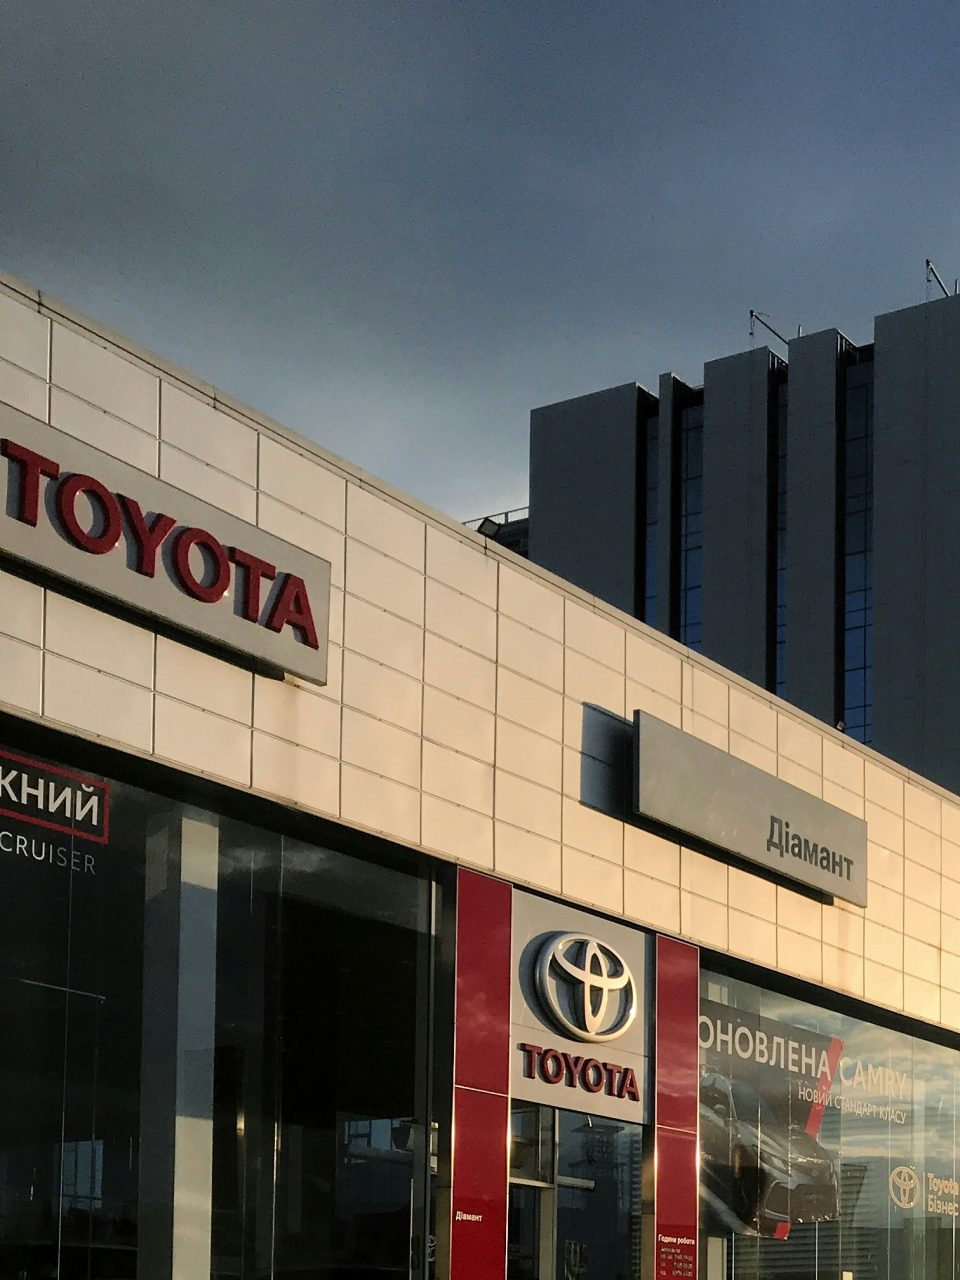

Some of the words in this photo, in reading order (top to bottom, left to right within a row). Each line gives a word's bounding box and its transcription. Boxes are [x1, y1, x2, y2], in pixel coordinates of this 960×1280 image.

[1, 438, 319, 650] TOYOTA
[0, 831, 97, 875] CRUISER
[767, 815, 854, 881] Діамант
[518, 1042, 640, 1102] TOYOTA
[699, 1015, 832, 1081] ОНОВЛЕНА
[839, 1056, 907, 1100] CAMRY
[798, 1085, 832, 1107] НОВИЙ
[834, 1095, 877, 1118] СТАНДАРТ
[879, 1107, 907, 1124] КЛАСУ
[927, 1172, 959, 1196] Toyota
[927, 1194, 959, 1216] Бізнес
[455, 1210, 483, 1222] Діамант
